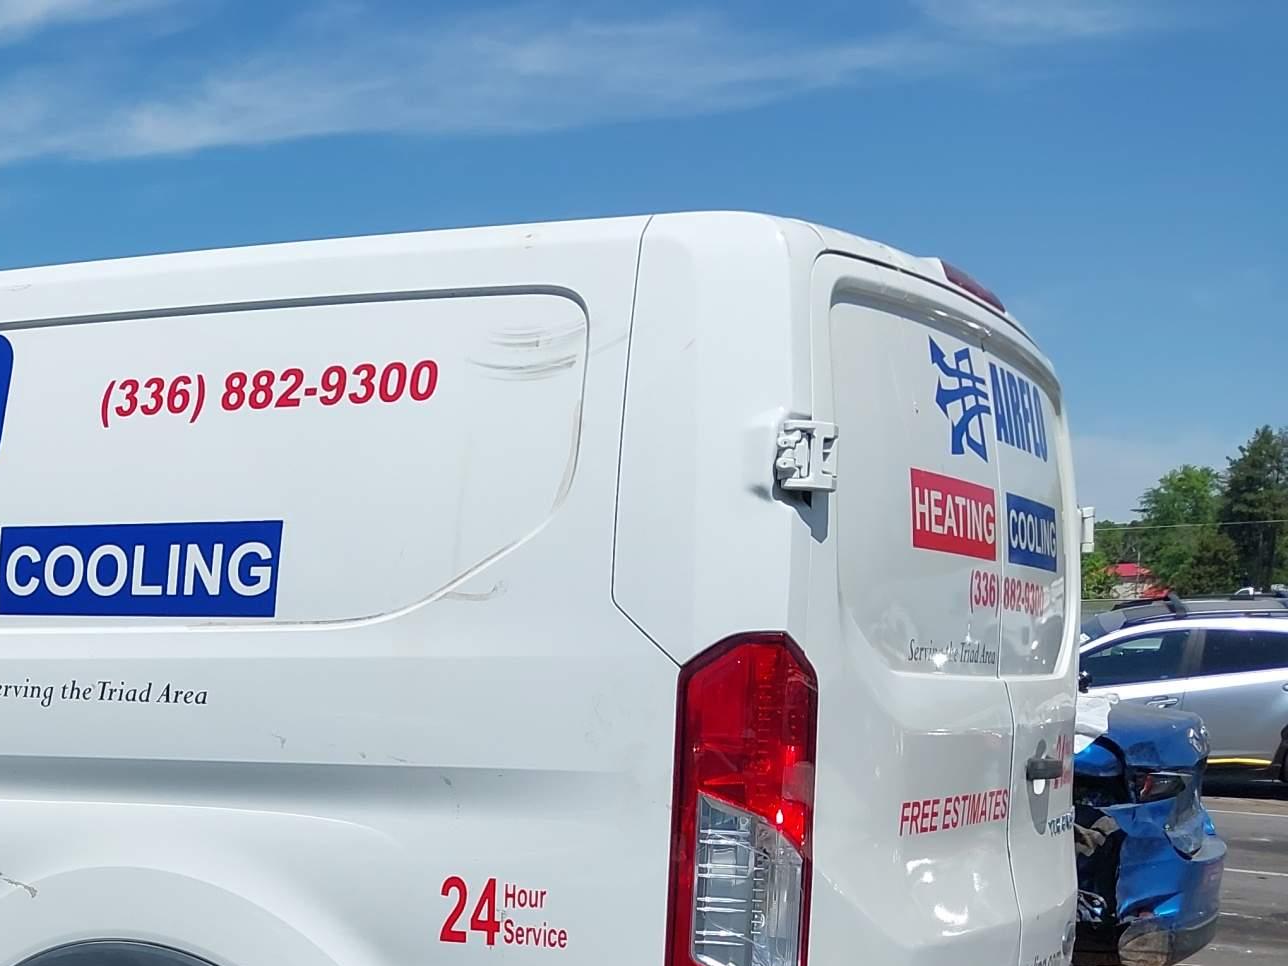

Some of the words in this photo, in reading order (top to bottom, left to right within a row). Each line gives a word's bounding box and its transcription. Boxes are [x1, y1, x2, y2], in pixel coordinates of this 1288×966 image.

[100, 374, 206, 428] (336)
[220, 360, 439, 411] 882-9300
[988, 362, 1048, 463] AIRFLO
[915, 486, 996, 545] HEATING
[1009, 508, 1057, 558] COOLING
[5, 542, 274, 598] COOLING
[970, 569, 1000, 618] (336)
[1003, 576, 1045, 617] 882-9300
[960, 641, 980, 664] Triad
[980, 643, 996, 665] Area
[61, 680, 92, 701] the
[97, 681, 153, 703] Triad
[156, 683, 209, 705] Area
[899, 798, 941, 837] FREE
[942, 788, 1009, 830] ESTIMATES
[439, 875, 501, 947] 24
[504, 883, 547, 909] Hour
[502, 918, 568, 949] Service
